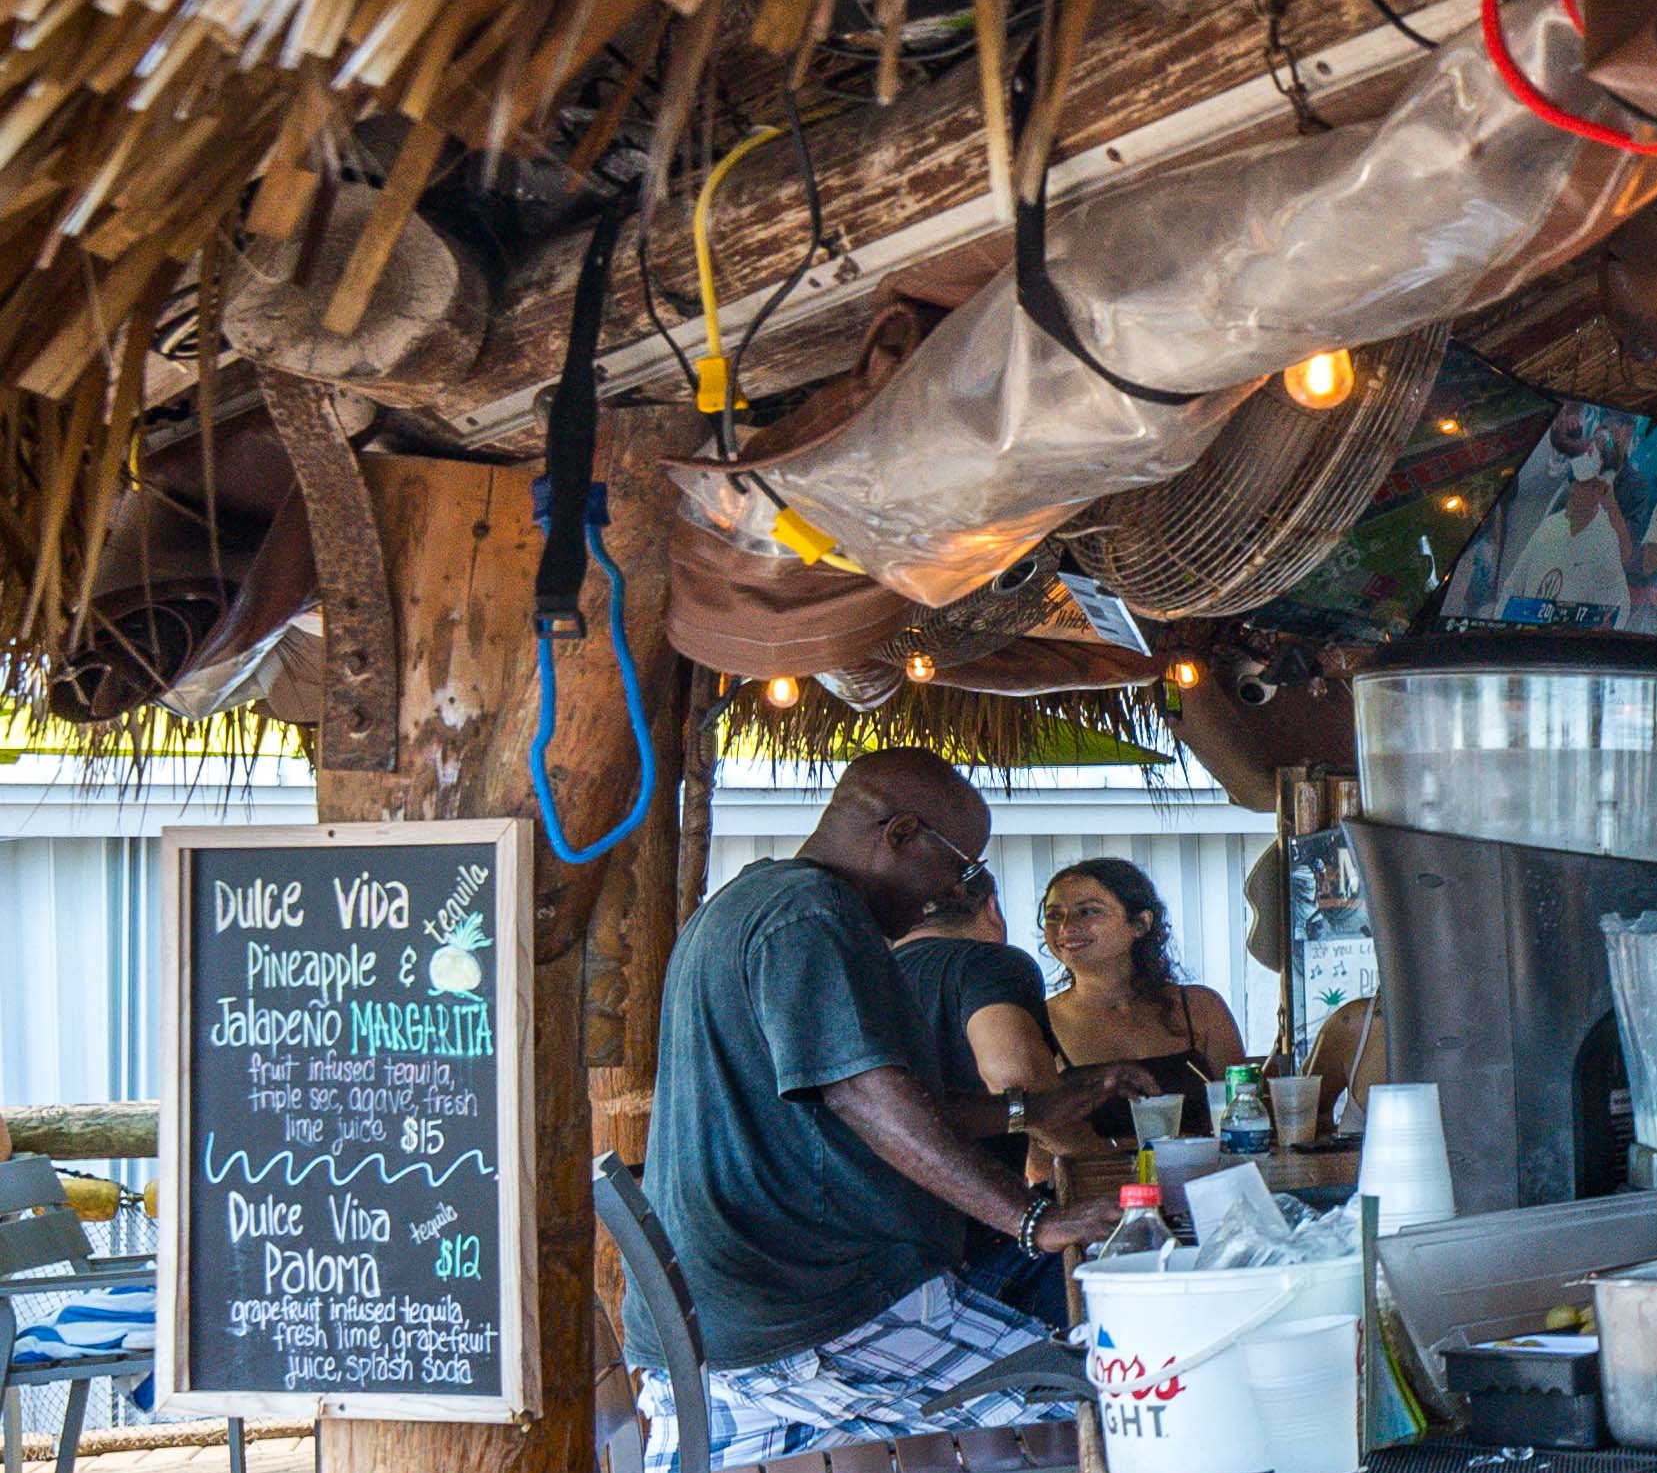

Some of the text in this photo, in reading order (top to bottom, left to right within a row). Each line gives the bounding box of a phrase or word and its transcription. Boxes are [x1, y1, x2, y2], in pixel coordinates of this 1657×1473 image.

[215, 877, 305, 934] Dulce
[422, 863, 489, 945] tequila
[398, 944, 418, 988] &
[350, 999, 495, 1057] MARGARITA
[249, 1050, 455, 1091] fruit infused tequila,
[248, 1084, 478, 1123] triple sec, agave, fresh
[285, 1114, 446, 1156] lime juice $15
[229, 1190, 304, 1244] Dulce
[408, 1201, 459, 1245] tequila
[435, 1232, 481, 1281] $12
[330, 1295, 396, 1323] infused
[400, 1294, 470, 1331] tequila,
[272, 1321, 328, 1352] fresh
[337, 1324, 390, 1359] lime,
[285, 1353, 474, 1391] juice, splash soda
[1104, 1401, 1169, 1439] GHT
